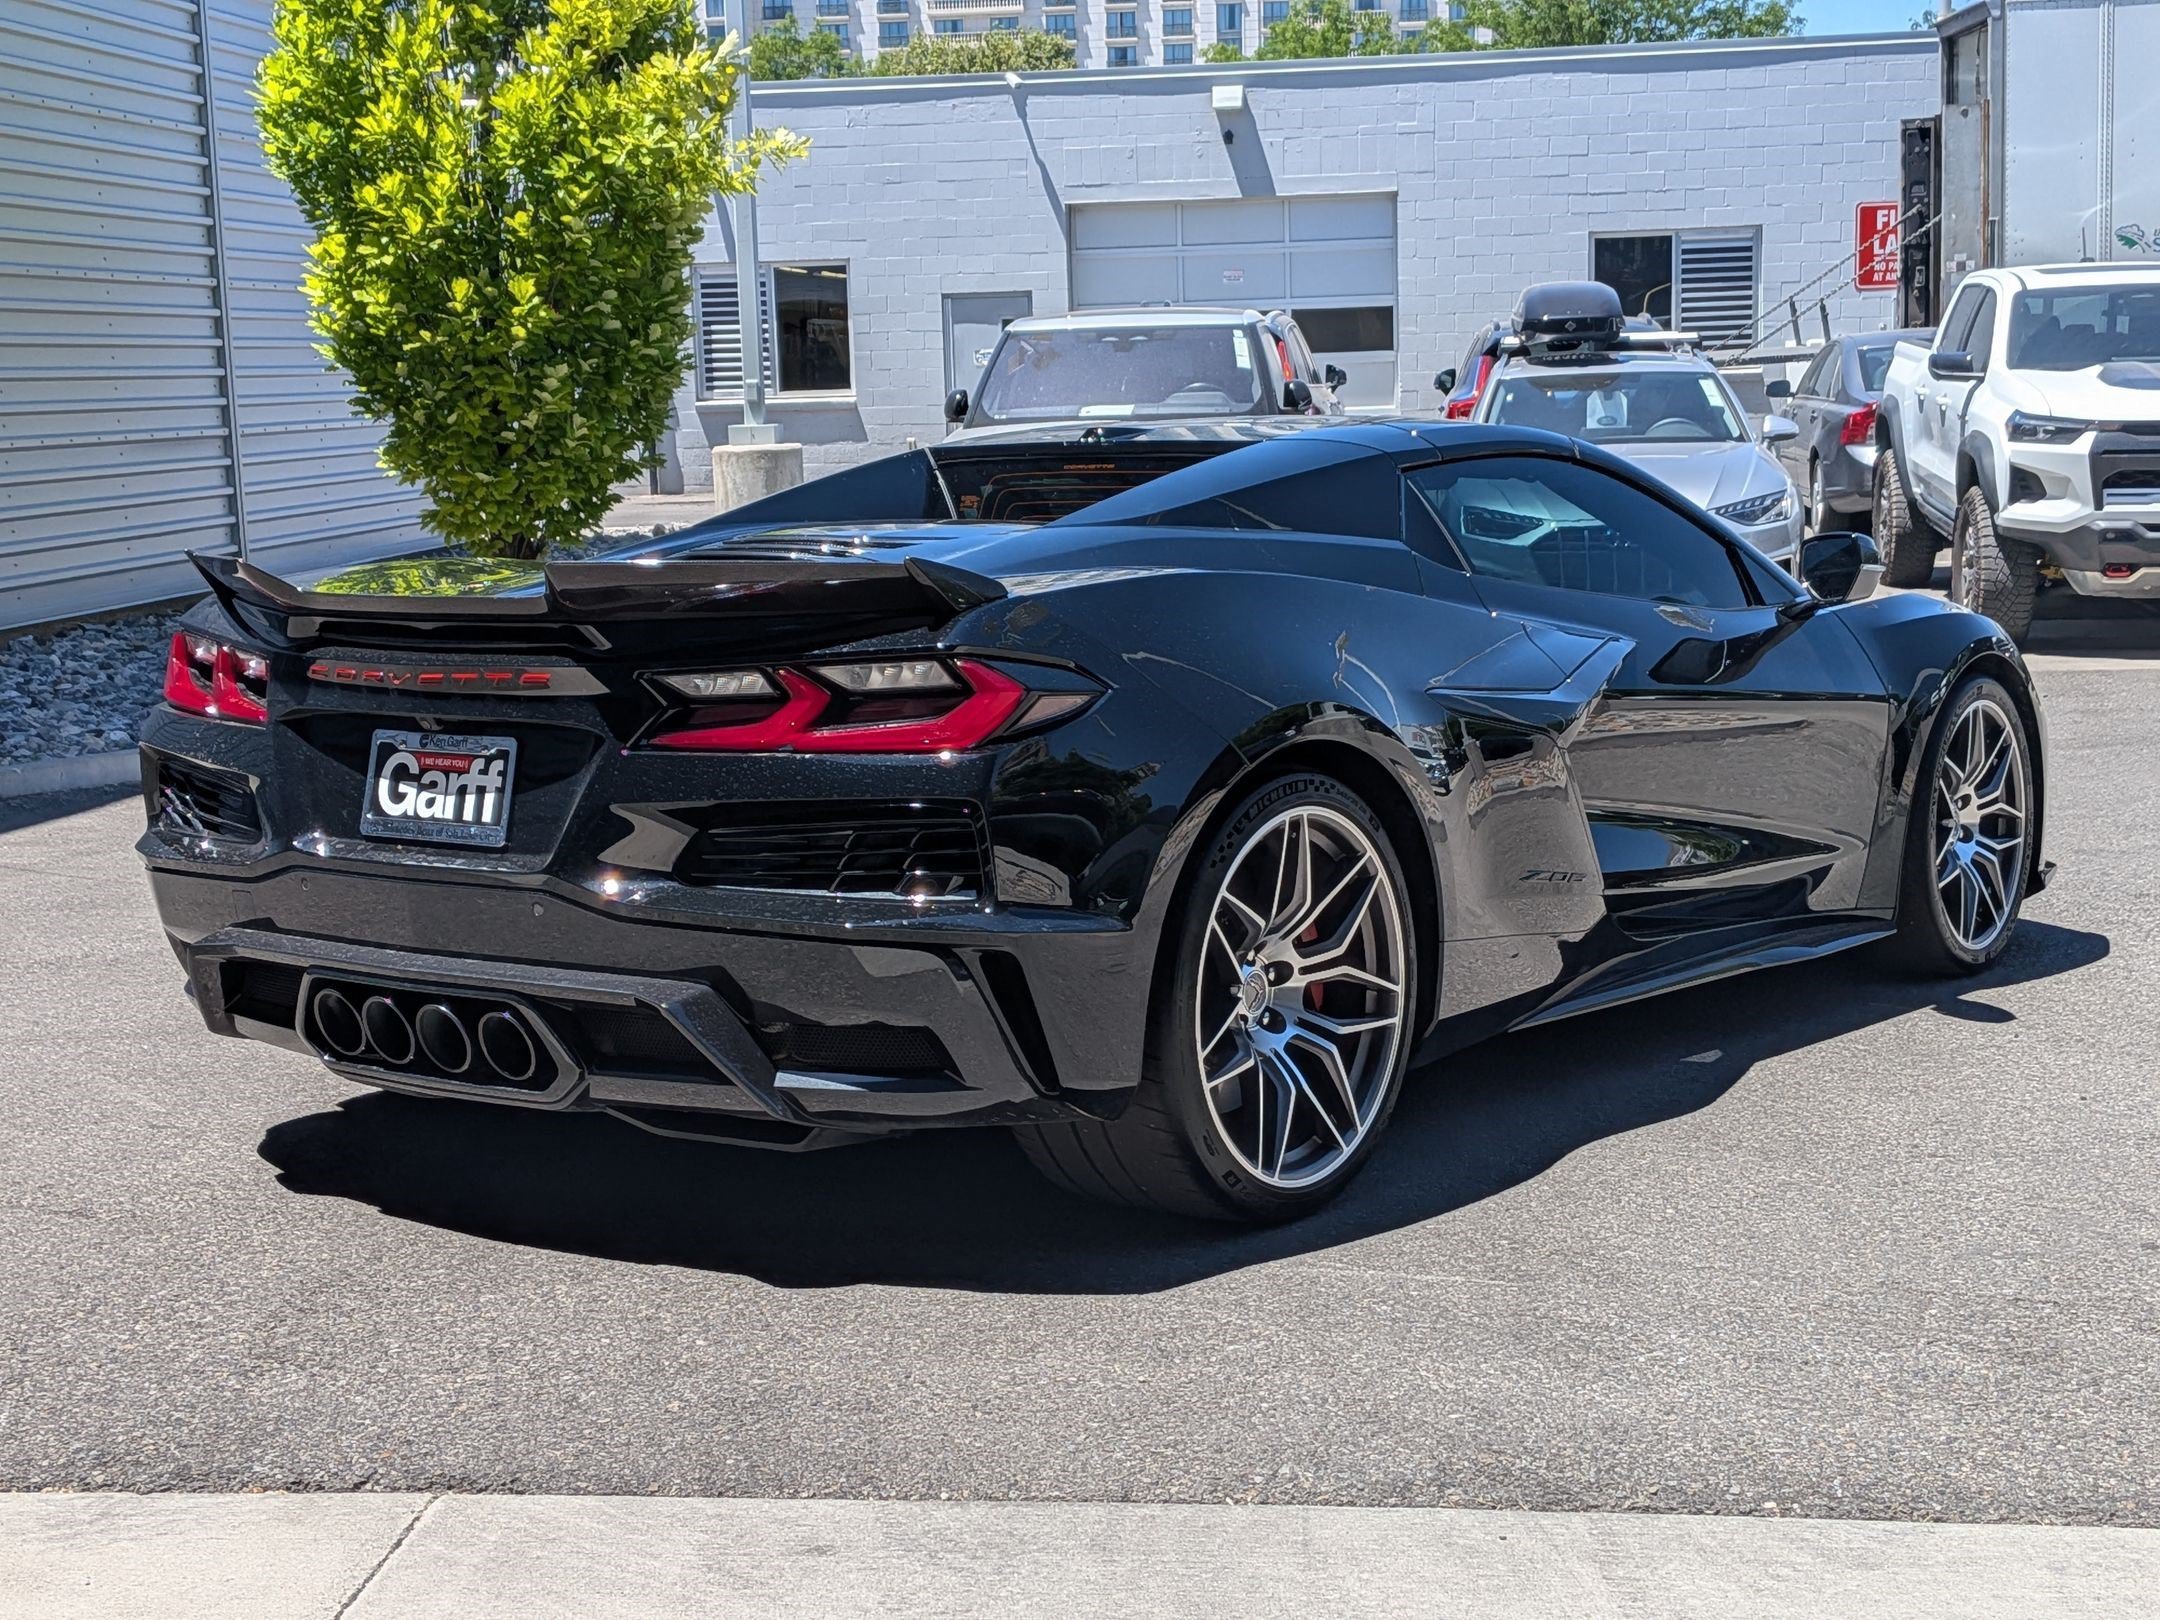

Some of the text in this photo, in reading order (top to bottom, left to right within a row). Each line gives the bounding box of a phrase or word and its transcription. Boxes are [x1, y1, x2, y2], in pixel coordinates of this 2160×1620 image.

[1876, 209, 1896, 230] FI
[1873, 234, 1897, 255] LA
[1873, 273, 1884, 282] AT
[307, 664, 551, 687] CORVETTE
[429, 734, 468, 748] Ken Garff
[435, 758, 451, 766] HEAR
[452, 759, 464, 768] YOU
[378, 752, 504, 823] Garff
